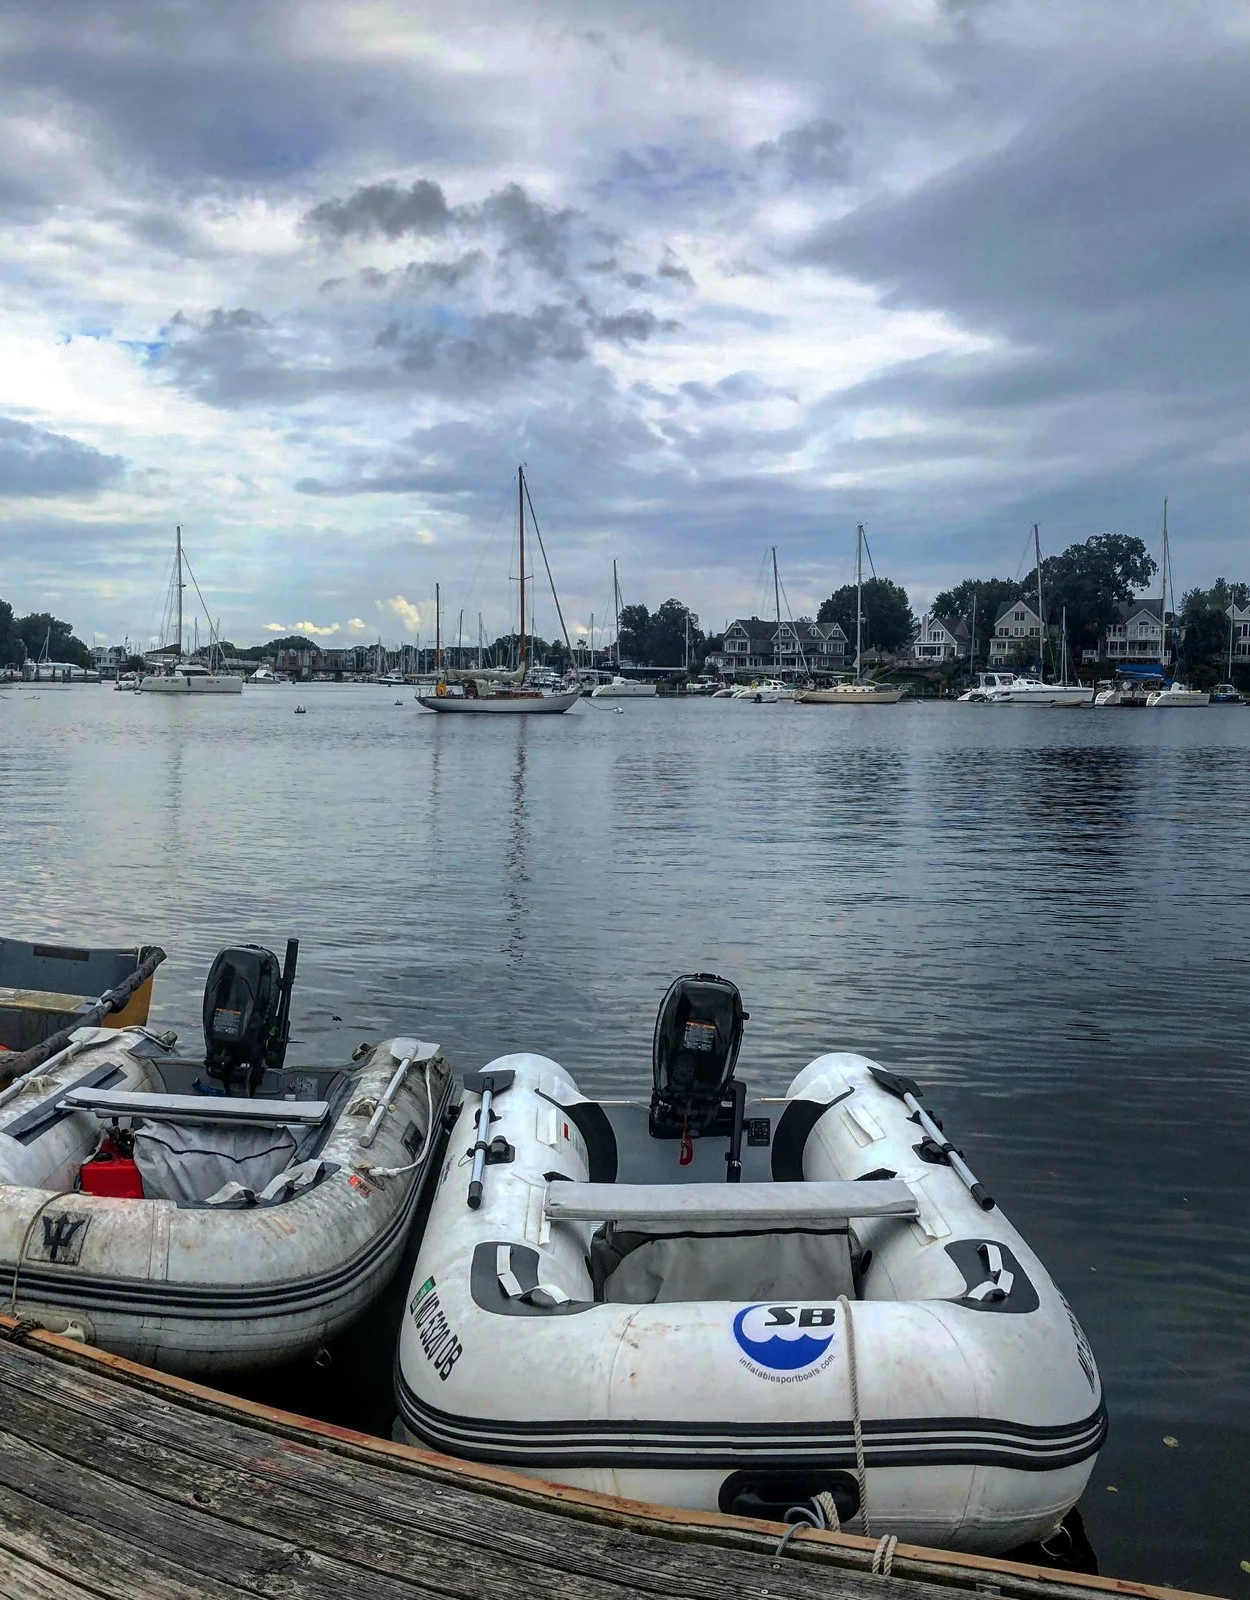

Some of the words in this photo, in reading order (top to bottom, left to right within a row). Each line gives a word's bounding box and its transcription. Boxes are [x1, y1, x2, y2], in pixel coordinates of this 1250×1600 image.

[764, 1306, 836, 1328] SB
[433, 1334, 463, 1382] DB
[738, 1353, 836, 1384] inflatablesportboats.com
